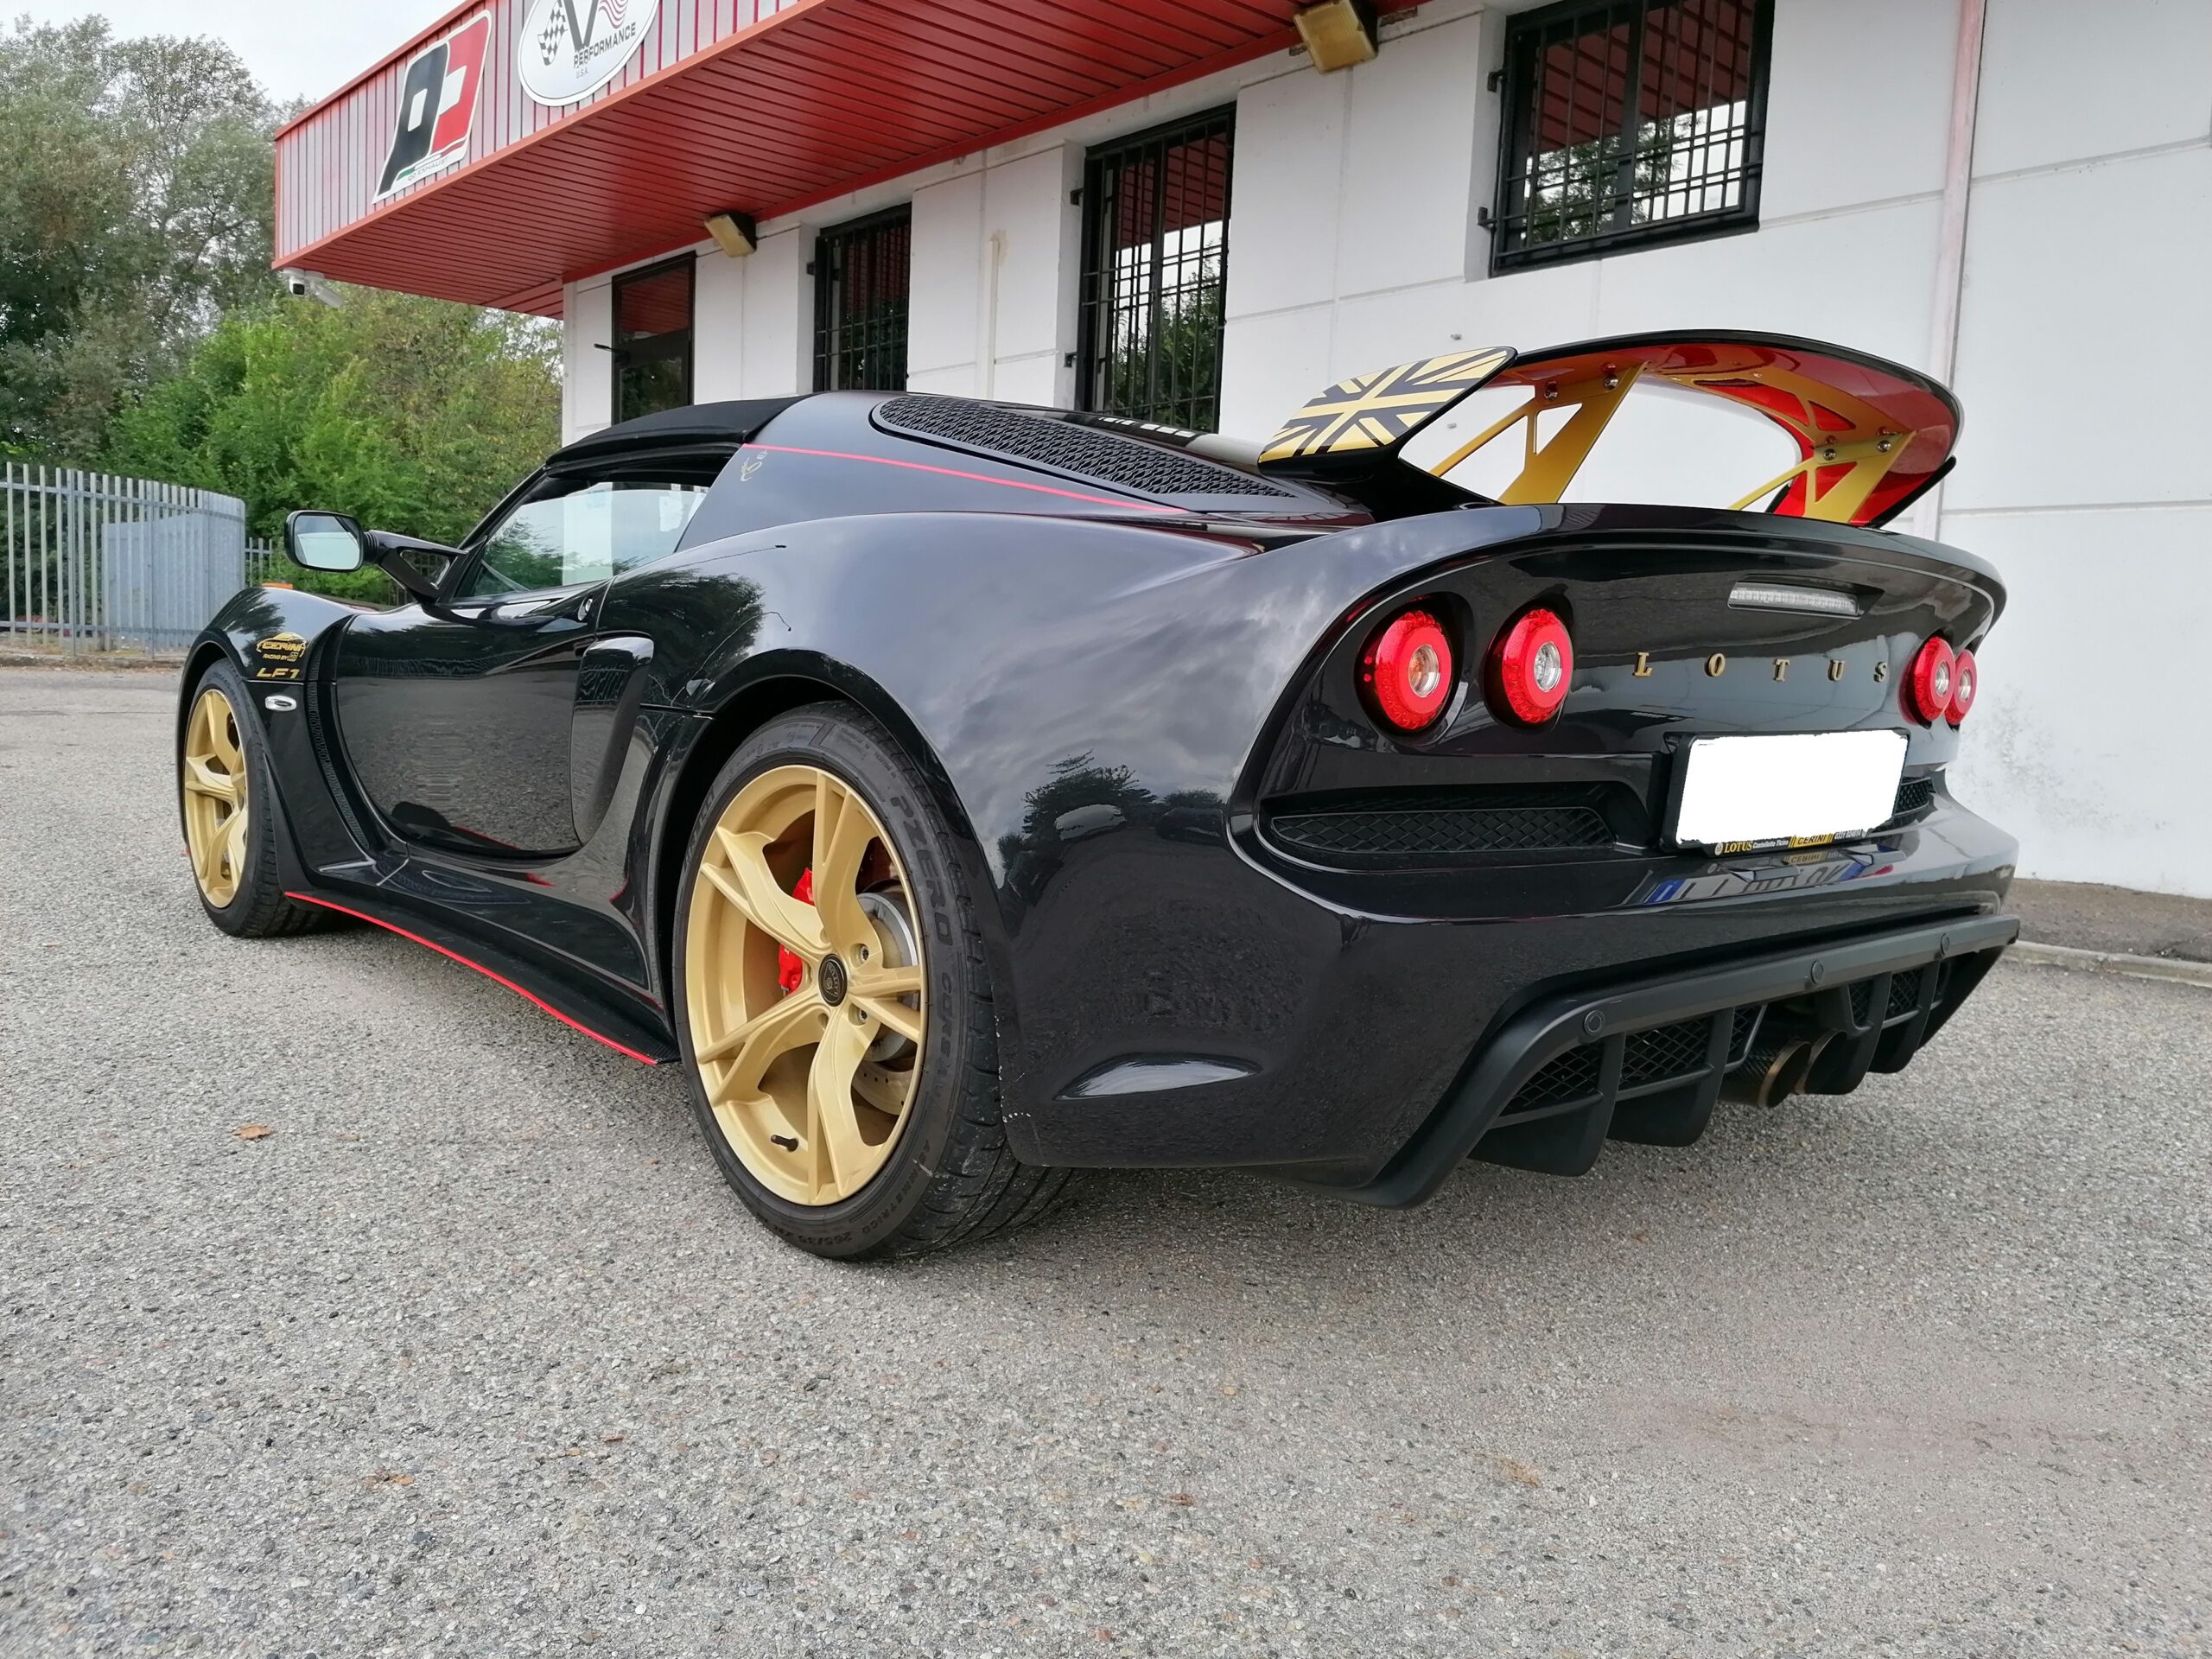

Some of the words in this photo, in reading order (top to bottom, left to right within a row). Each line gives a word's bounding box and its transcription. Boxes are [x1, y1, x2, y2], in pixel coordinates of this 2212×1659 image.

[573, 22, 637, 68] PERFORMANCE
[256, 667, 300, 679] LF1
[1631, 652, 1889, 683] LOTUS
[1724, 841, 1752, 853] LOTUS
[1797, 834, 1826, 845] CERINI
